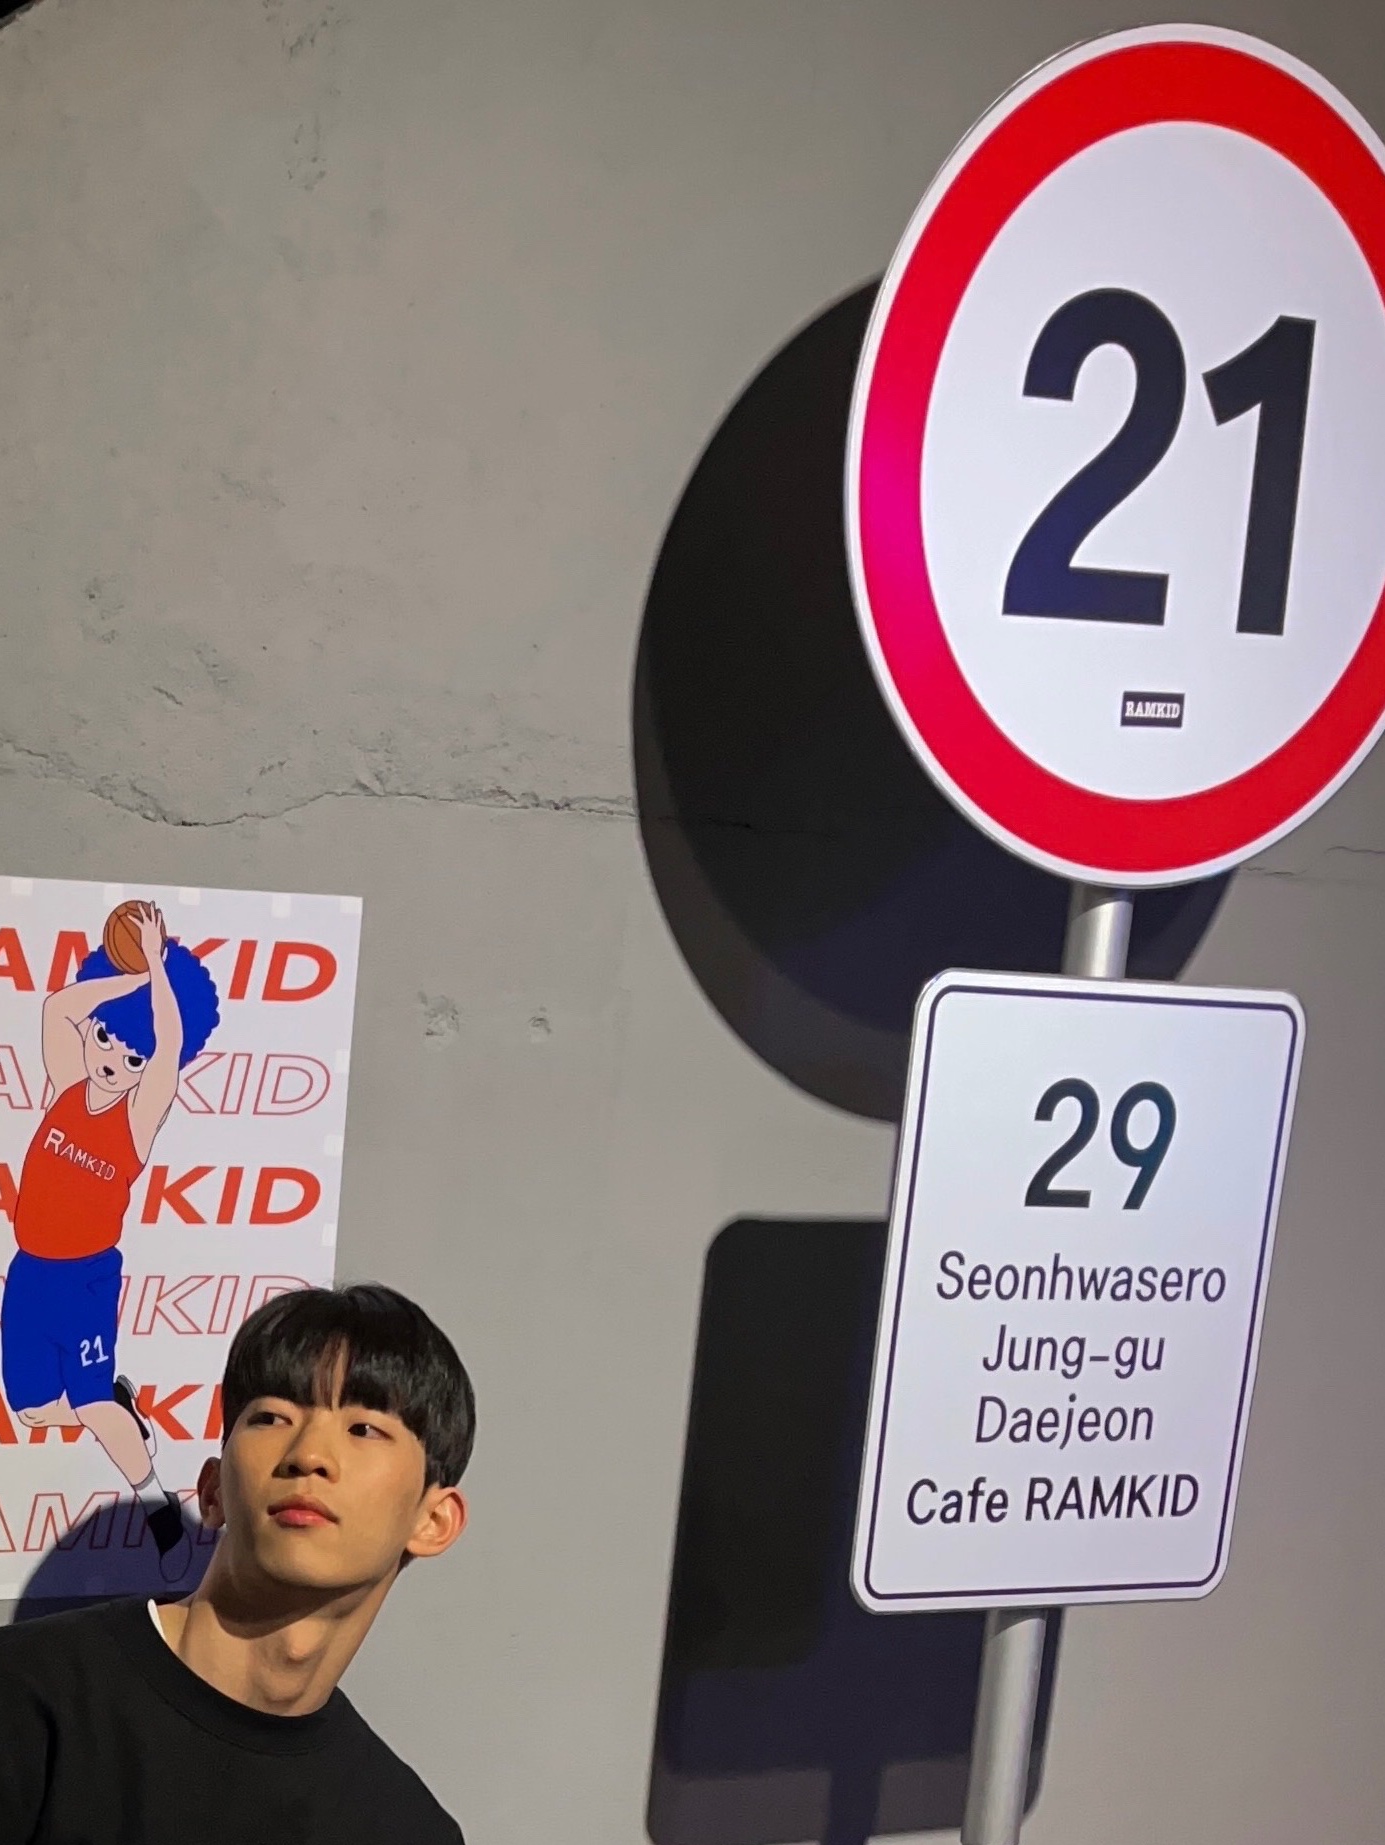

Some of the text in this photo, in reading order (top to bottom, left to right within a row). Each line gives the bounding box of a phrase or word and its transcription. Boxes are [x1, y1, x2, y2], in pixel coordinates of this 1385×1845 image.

[1001, 286, 1316, 637] 21
[1124, 701, 1181, 718] RAMKID
[1024, 1077, 1177, 1211] 29
[935, 1250, 1227, 1302] Seonhwasero
[79, 1335, 109, 1368] 21
[982, 1323, 1165, 1380] Jung-gu
[975, 1393, 1153, 1450] Daejeon
[906, 1472, 1199, 1524] Cafe RAMKID
